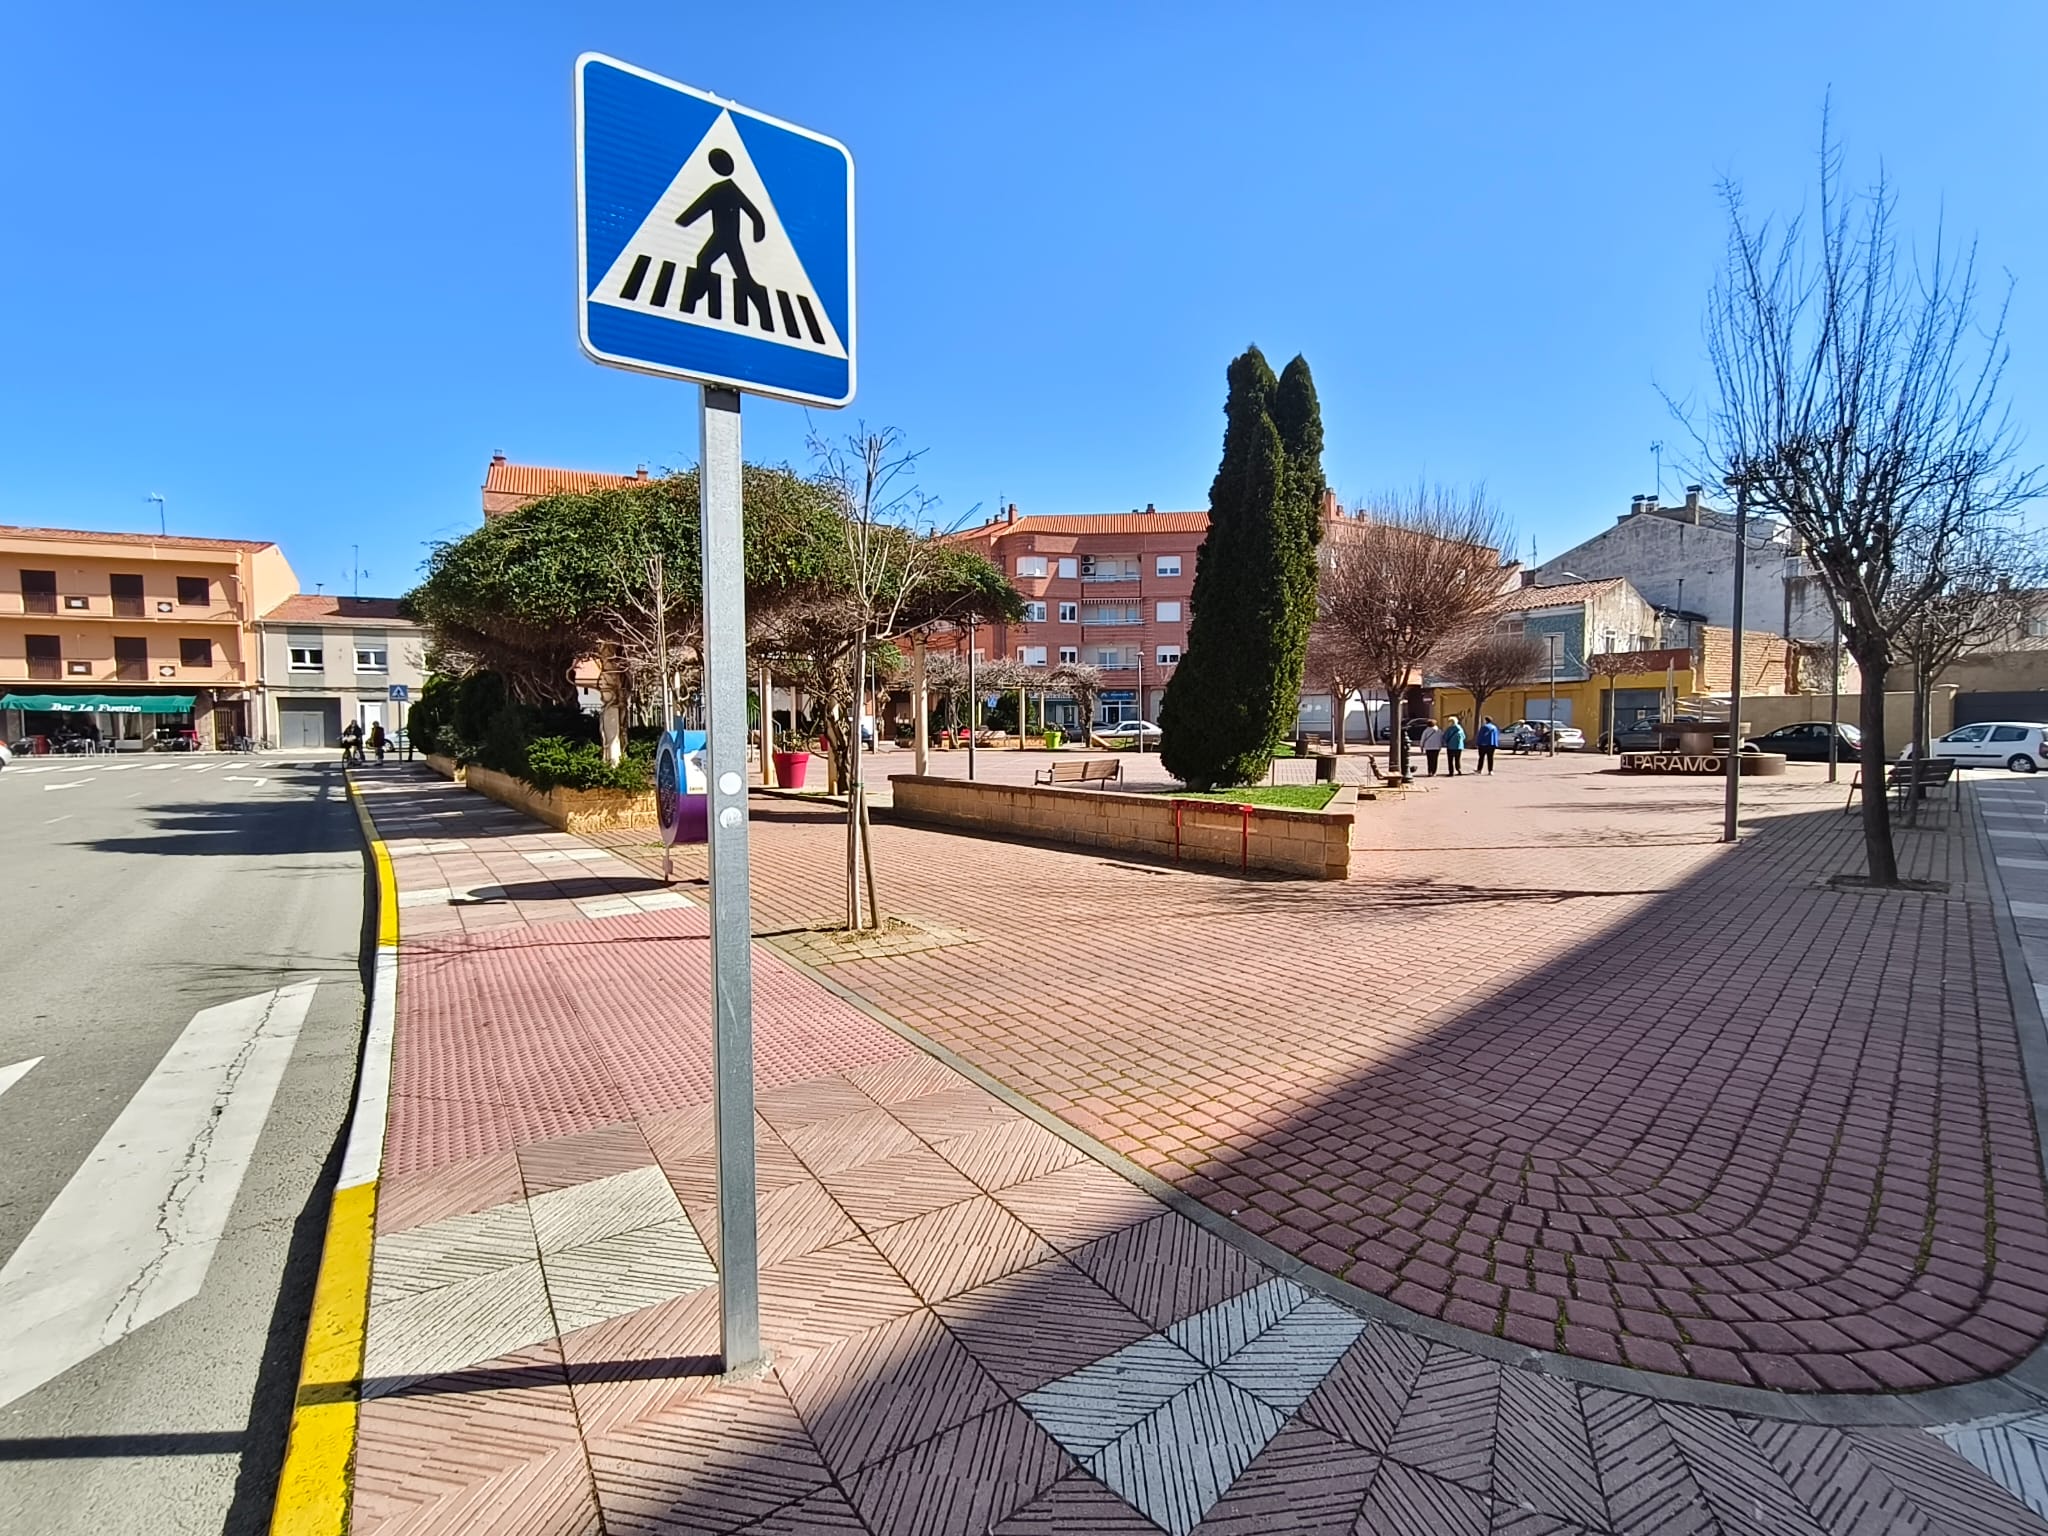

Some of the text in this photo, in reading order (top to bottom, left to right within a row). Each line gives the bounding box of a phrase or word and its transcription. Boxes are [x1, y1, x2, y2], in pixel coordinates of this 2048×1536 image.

[50, 703, 75, 711] Bar
[97, 704, 141, 712] Fuente
[1621, 755, 1721, 771] EL PARAMO
